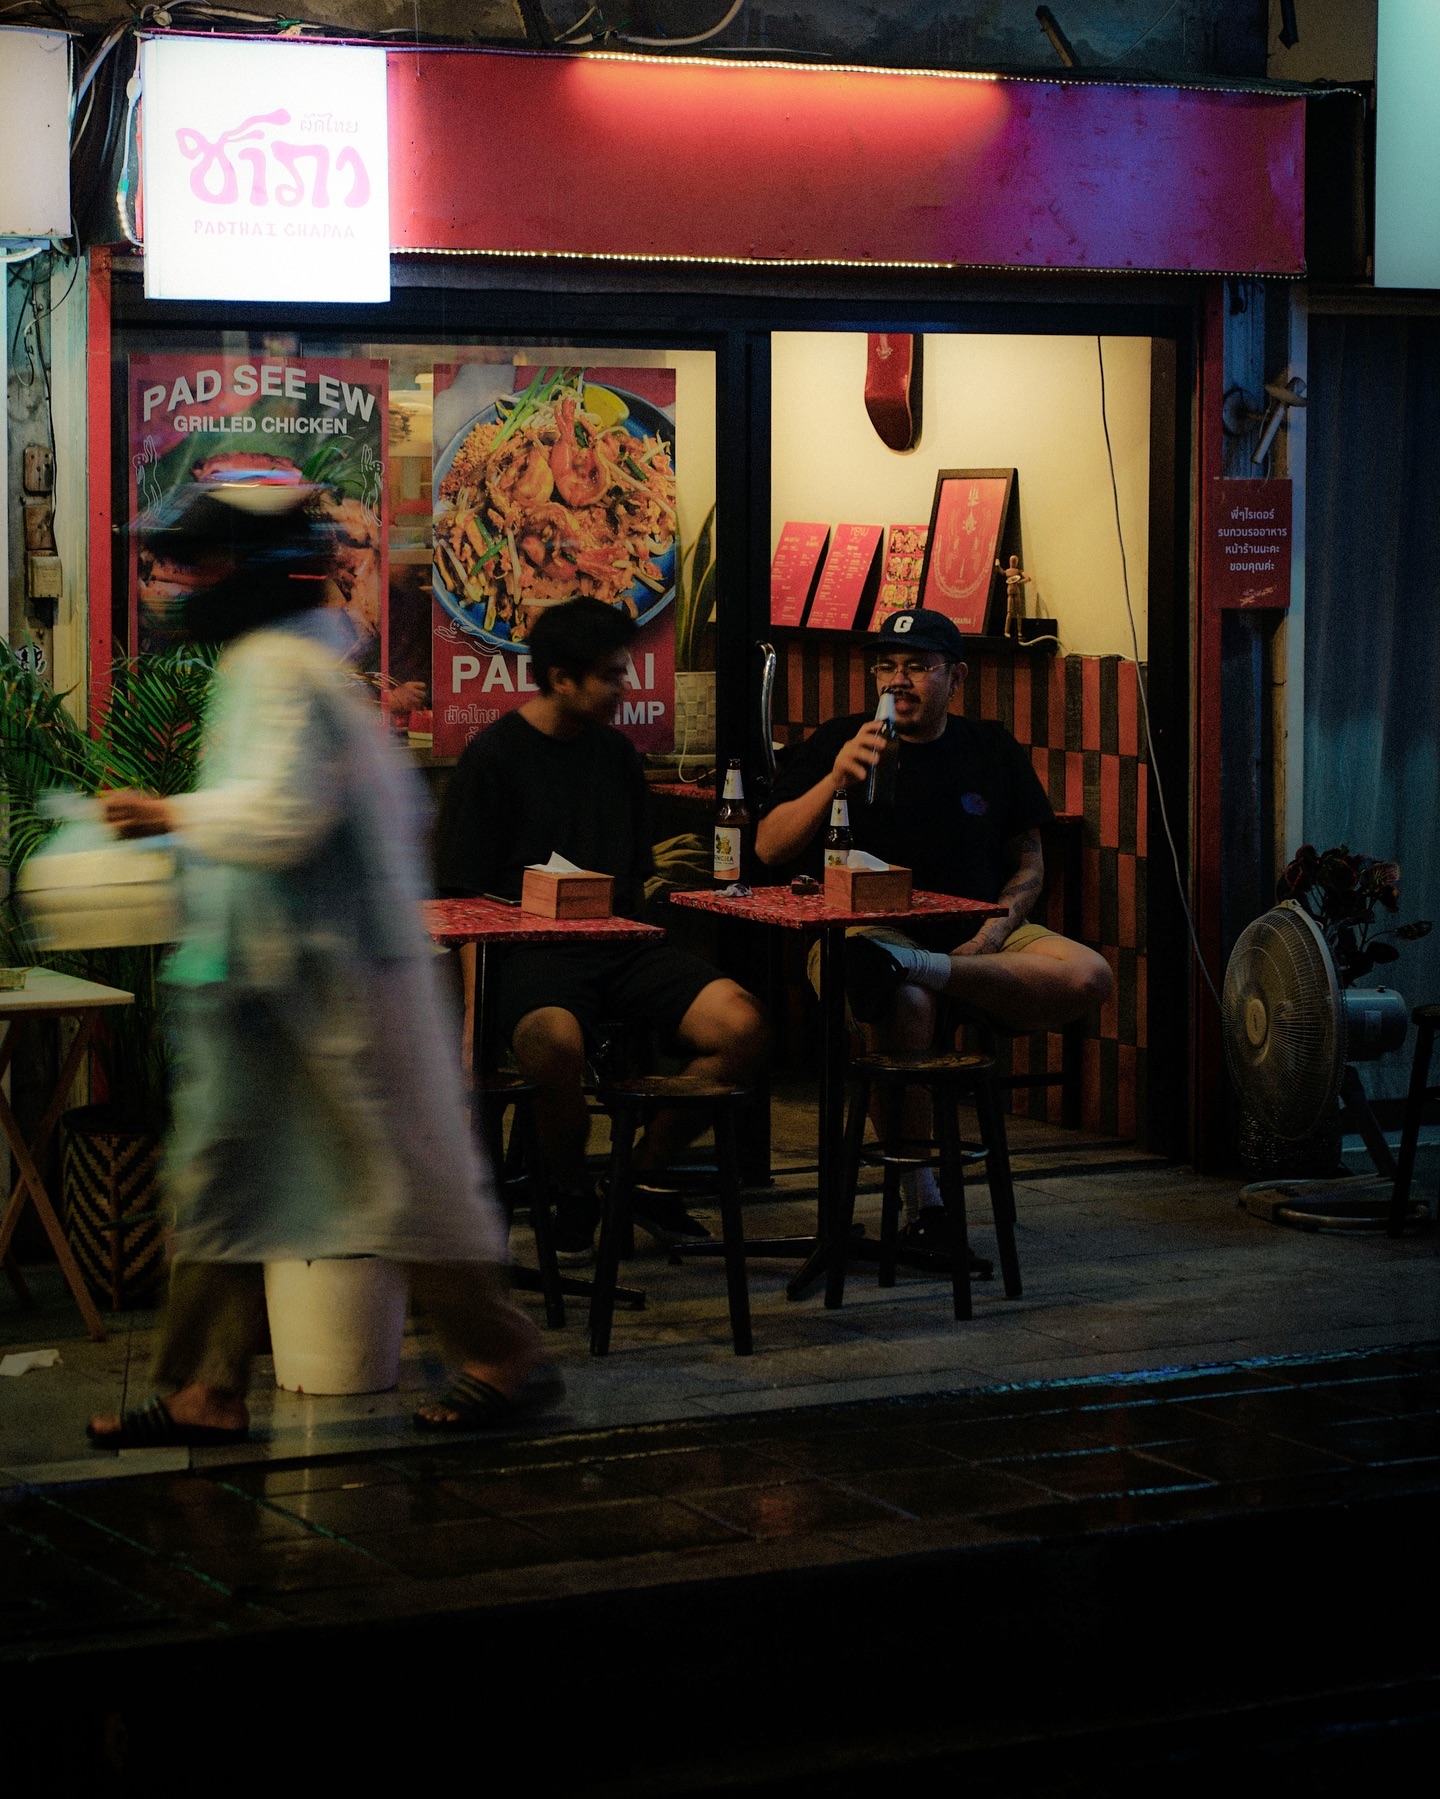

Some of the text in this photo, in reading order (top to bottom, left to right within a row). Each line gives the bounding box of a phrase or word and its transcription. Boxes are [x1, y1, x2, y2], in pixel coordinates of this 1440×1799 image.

[300, 112, 359, 134] ผัดไทย
[193, 219, 356, 239] PADTHAI CHAPAA
[143, 364, 376, 422] PAD SEE EW
[173, 415, 348, 434] GRILLED CHICKEN
[1218, 528, 1287, 537] รบกวนรออาหาร
[1225, 543, 1280, 554] หน้าร้านนะคะ
[1229, 560, 1275, 573] ขอบคุณค่ะ
[893, 616, 914, 633] G
